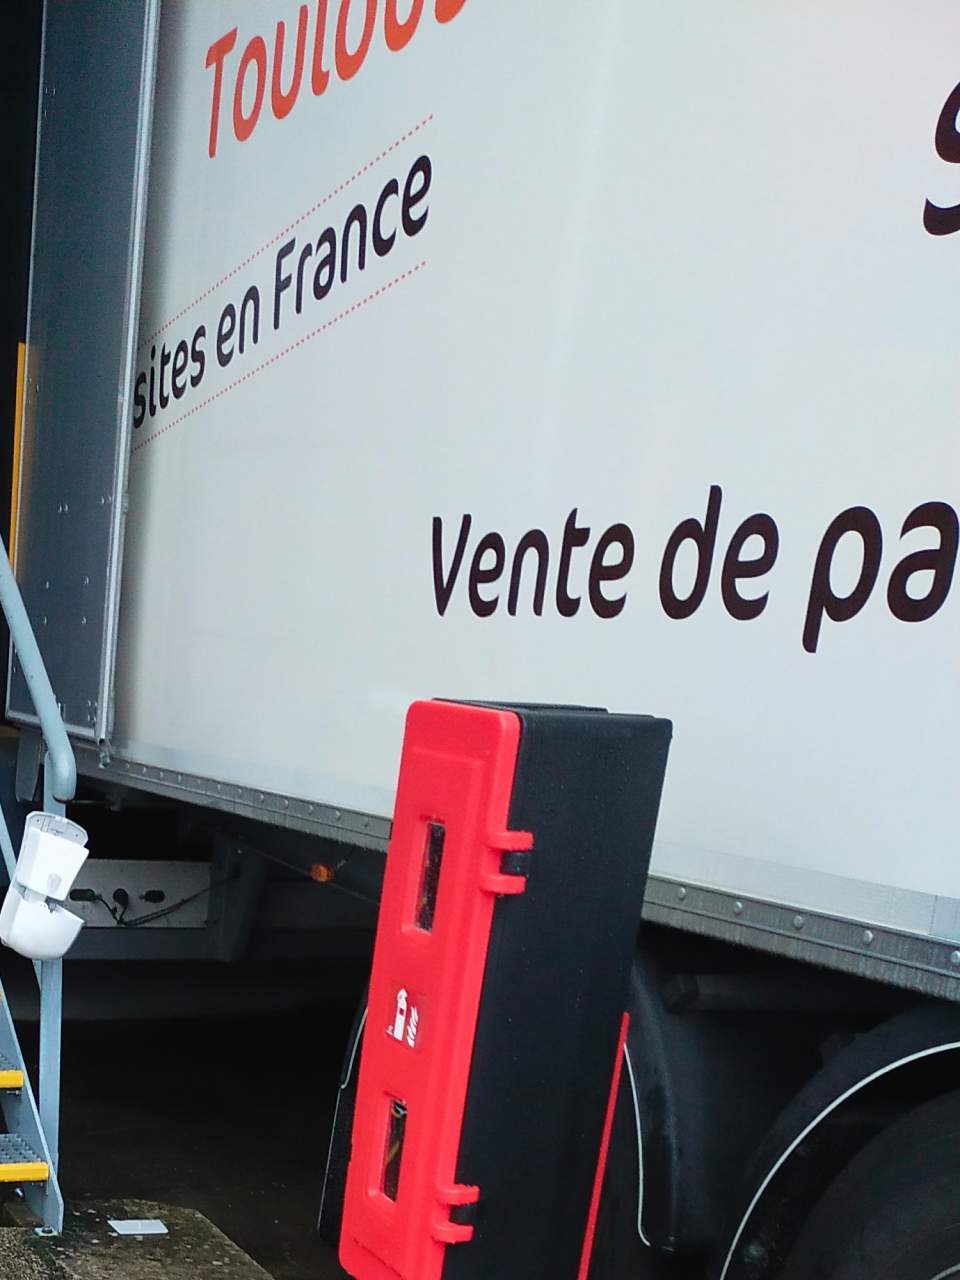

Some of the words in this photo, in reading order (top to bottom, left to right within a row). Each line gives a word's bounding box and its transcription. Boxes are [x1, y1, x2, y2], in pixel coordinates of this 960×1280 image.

[207, 0, 465, 156] Toulo
[133, 325, 206, 428] sites
[217, 286, 260, 368] en
[274, 155, 432, 330] France
[433, 508, 635, 619] Vente
[659, 485, 780, 621] de
[803, 502, 960, 654] pa
